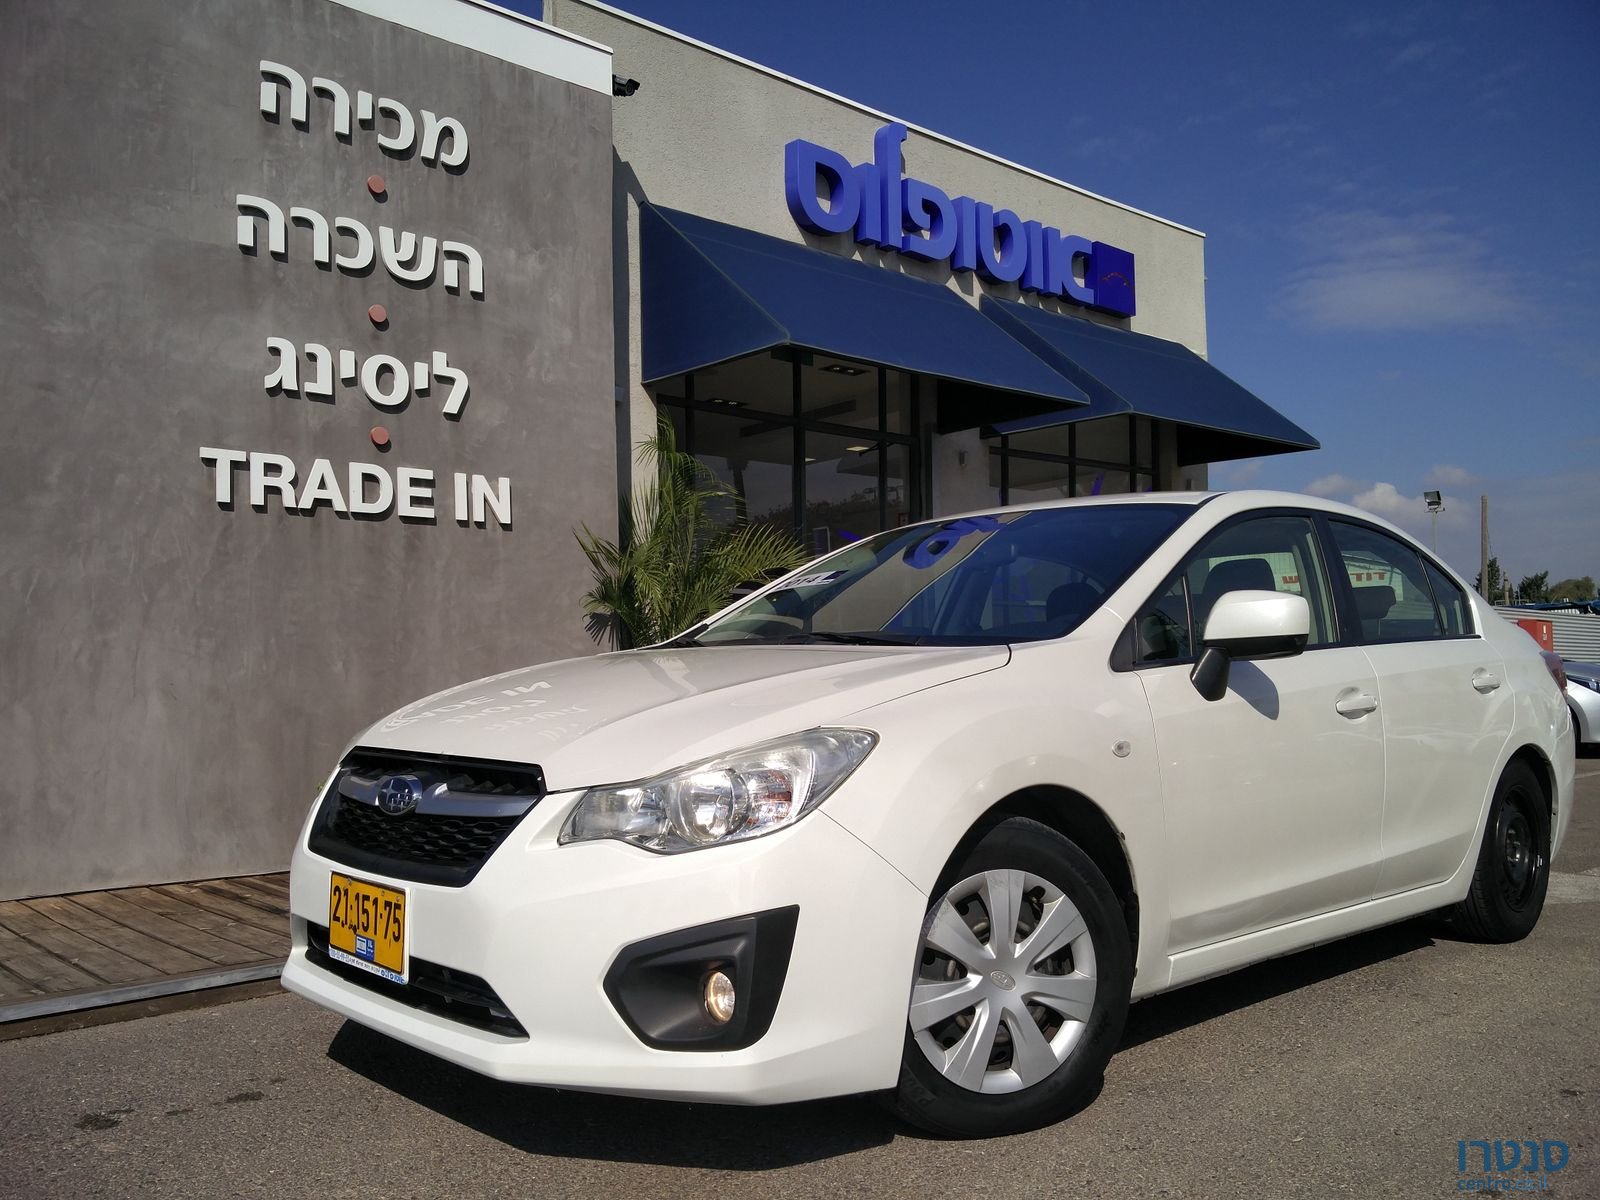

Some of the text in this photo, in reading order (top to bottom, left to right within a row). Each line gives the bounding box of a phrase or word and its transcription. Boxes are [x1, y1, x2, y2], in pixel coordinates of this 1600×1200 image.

[259, 60, 470, 167] מכירה
[236, 194, 484, 293] השכרה
[264, 336, 470, 414] ליסינג
[200, 446, 512, 525] TRADE IN
